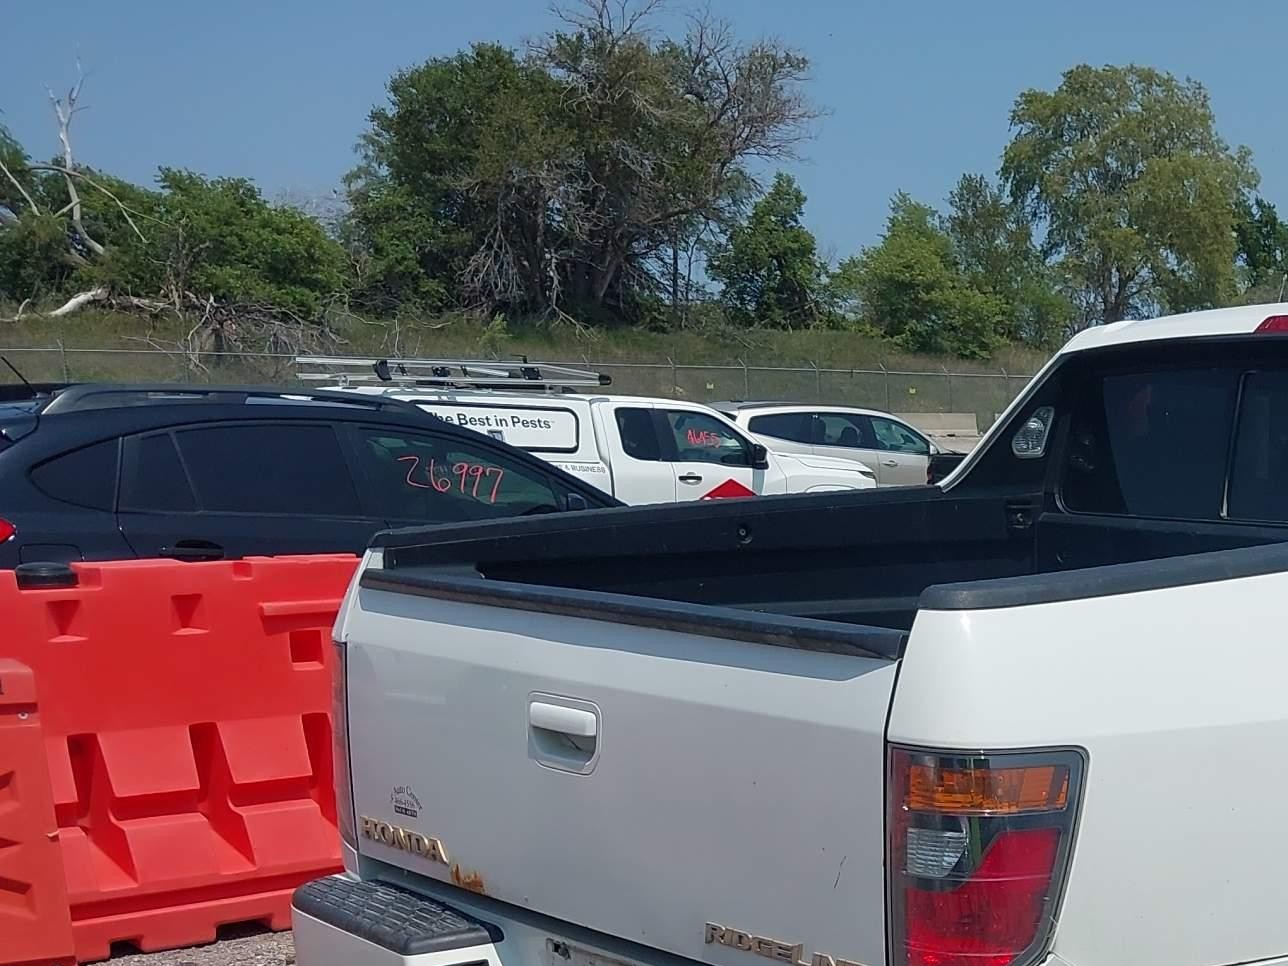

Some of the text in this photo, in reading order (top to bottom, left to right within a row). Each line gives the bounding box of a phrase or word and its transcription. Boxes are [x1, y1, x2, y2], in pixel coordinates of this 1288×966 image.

[456, 413, 492, 427] Best
[494, 415, 509, 428] in
[511, 415, 552, 429] Pests
[397, 456, 504, 504] 26997
[360, 816, 449, 865] HONDA
